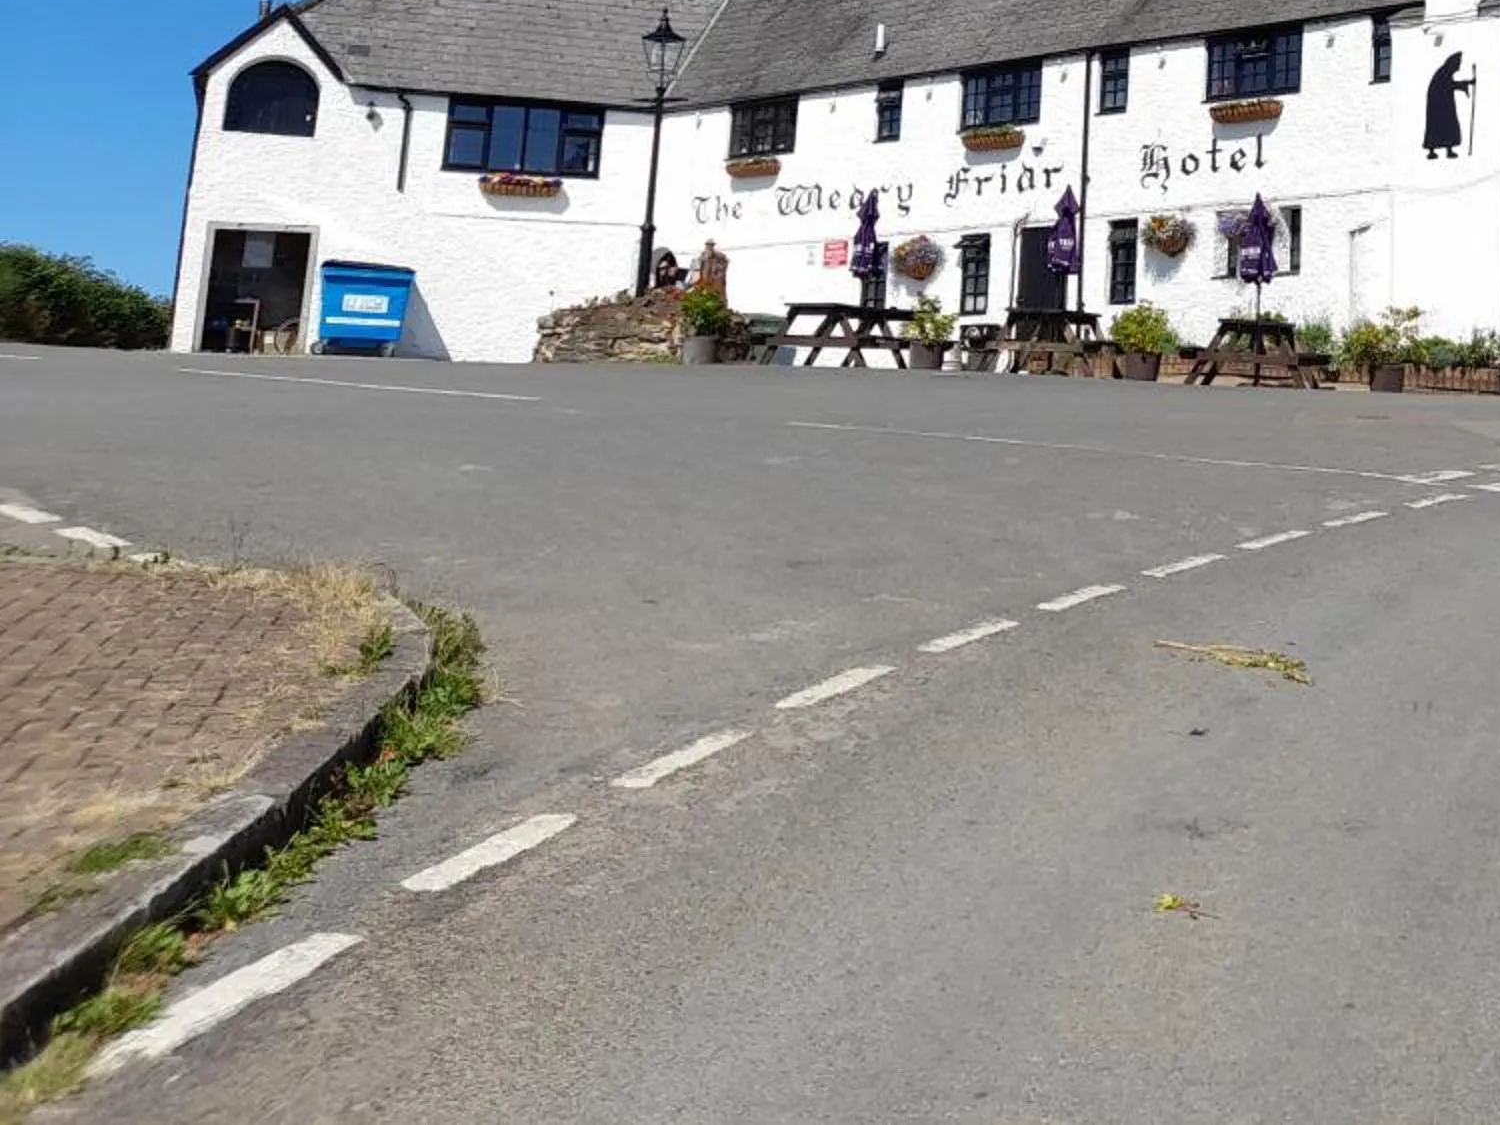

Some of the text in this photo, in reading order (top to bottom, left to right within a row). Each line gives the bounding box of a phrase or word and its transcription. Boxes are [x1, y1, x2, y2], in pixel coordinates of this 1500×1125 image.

[692, 194, 743, 224] The
[943, 162, 1063, 206] Friar
[1139, 133, 1267, 192] Hotel
